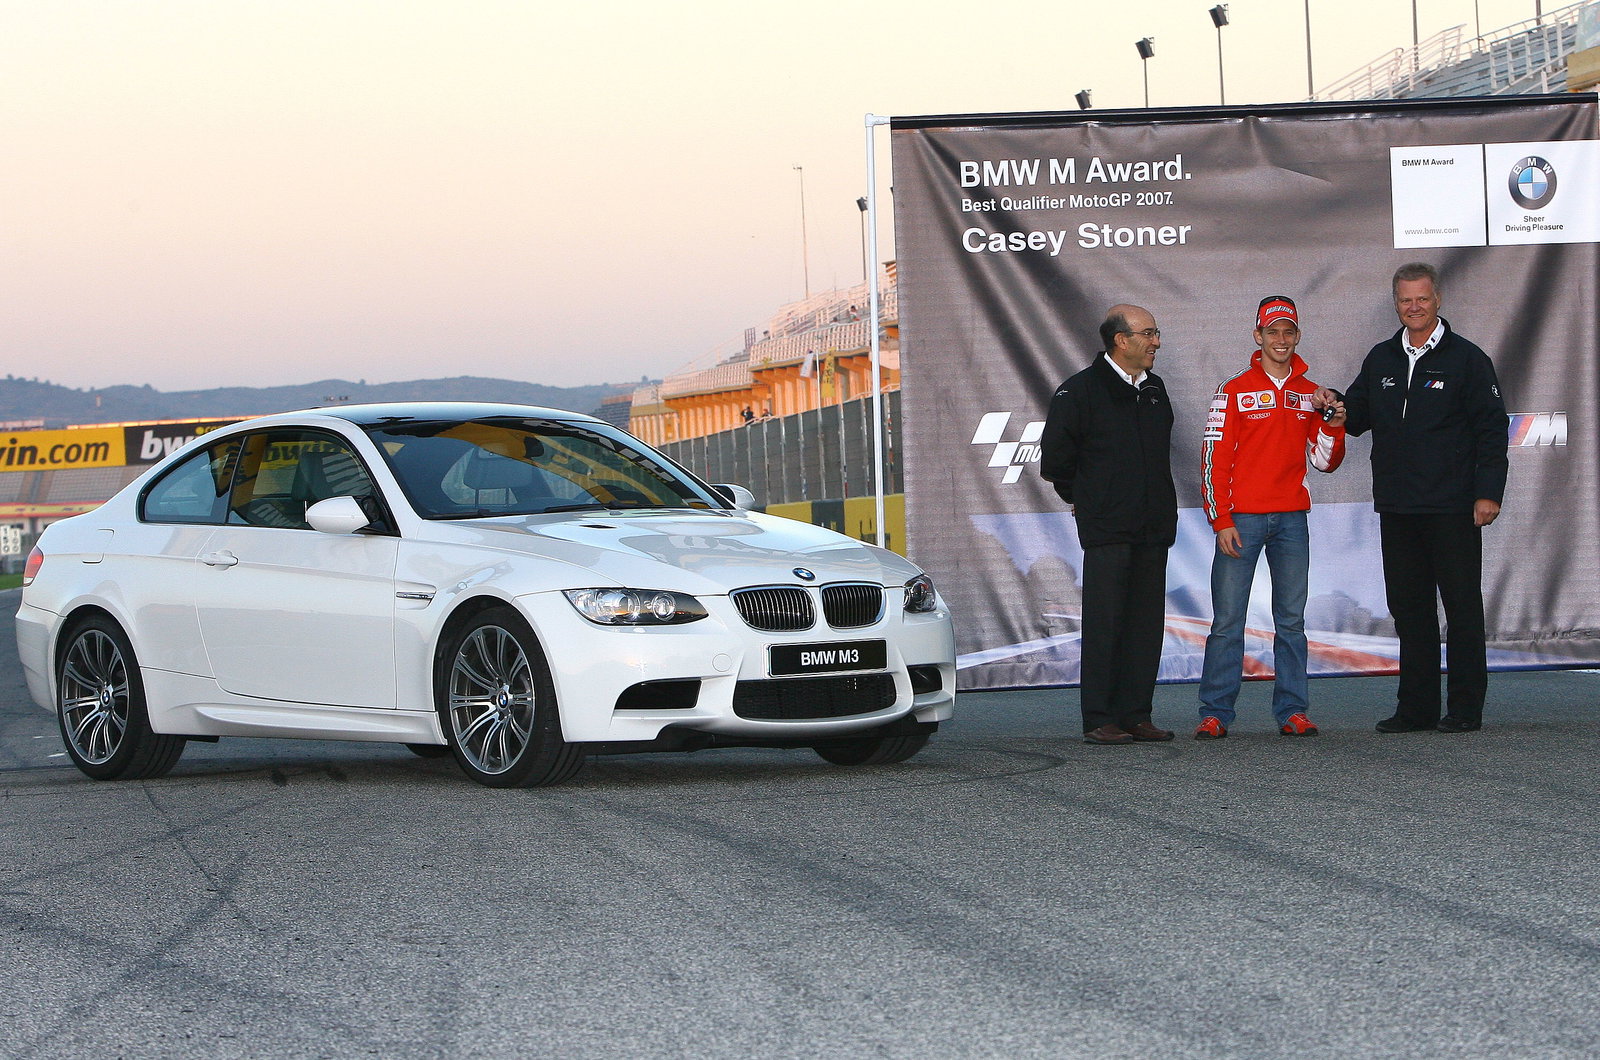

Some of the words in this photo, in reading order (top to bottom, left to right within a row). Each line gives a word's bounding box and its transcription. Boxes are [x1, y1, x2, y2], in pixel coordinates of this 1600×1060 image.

[959, 158, 1041, 188] BMW
[1049, 157, 1076, 185] M
[1085, 153, 1192, 183] Award.
[1401, 158, 1422, 167] BMW
[1422, 158, 1430, 166] M
[1430, 157, 1454, 166] Award
[1512, 157, 1553, 175] BMW
[961, 198, 996, 212] Best
[1000, 195, 1066, 212] Qualifier
[1069, 192, 1132, 209] MotoGP
[1136, 191, 1174, 206] 2007.
[1505, 224, 1531, 232] Driving
[1532, 223, 1564, 231] Pleasure
[1523, 215, 1545, 223] Sheer
[962, 227, 1067, 257] Casey
[1077, 222, 1192, 249] Stoner
[1404, 227, 1460, 235] www.bmw.com
[1013, 444, 1043, 463] mo
[801, 650, 837, 666] BMW
[838, 649, 860, 664] M3
